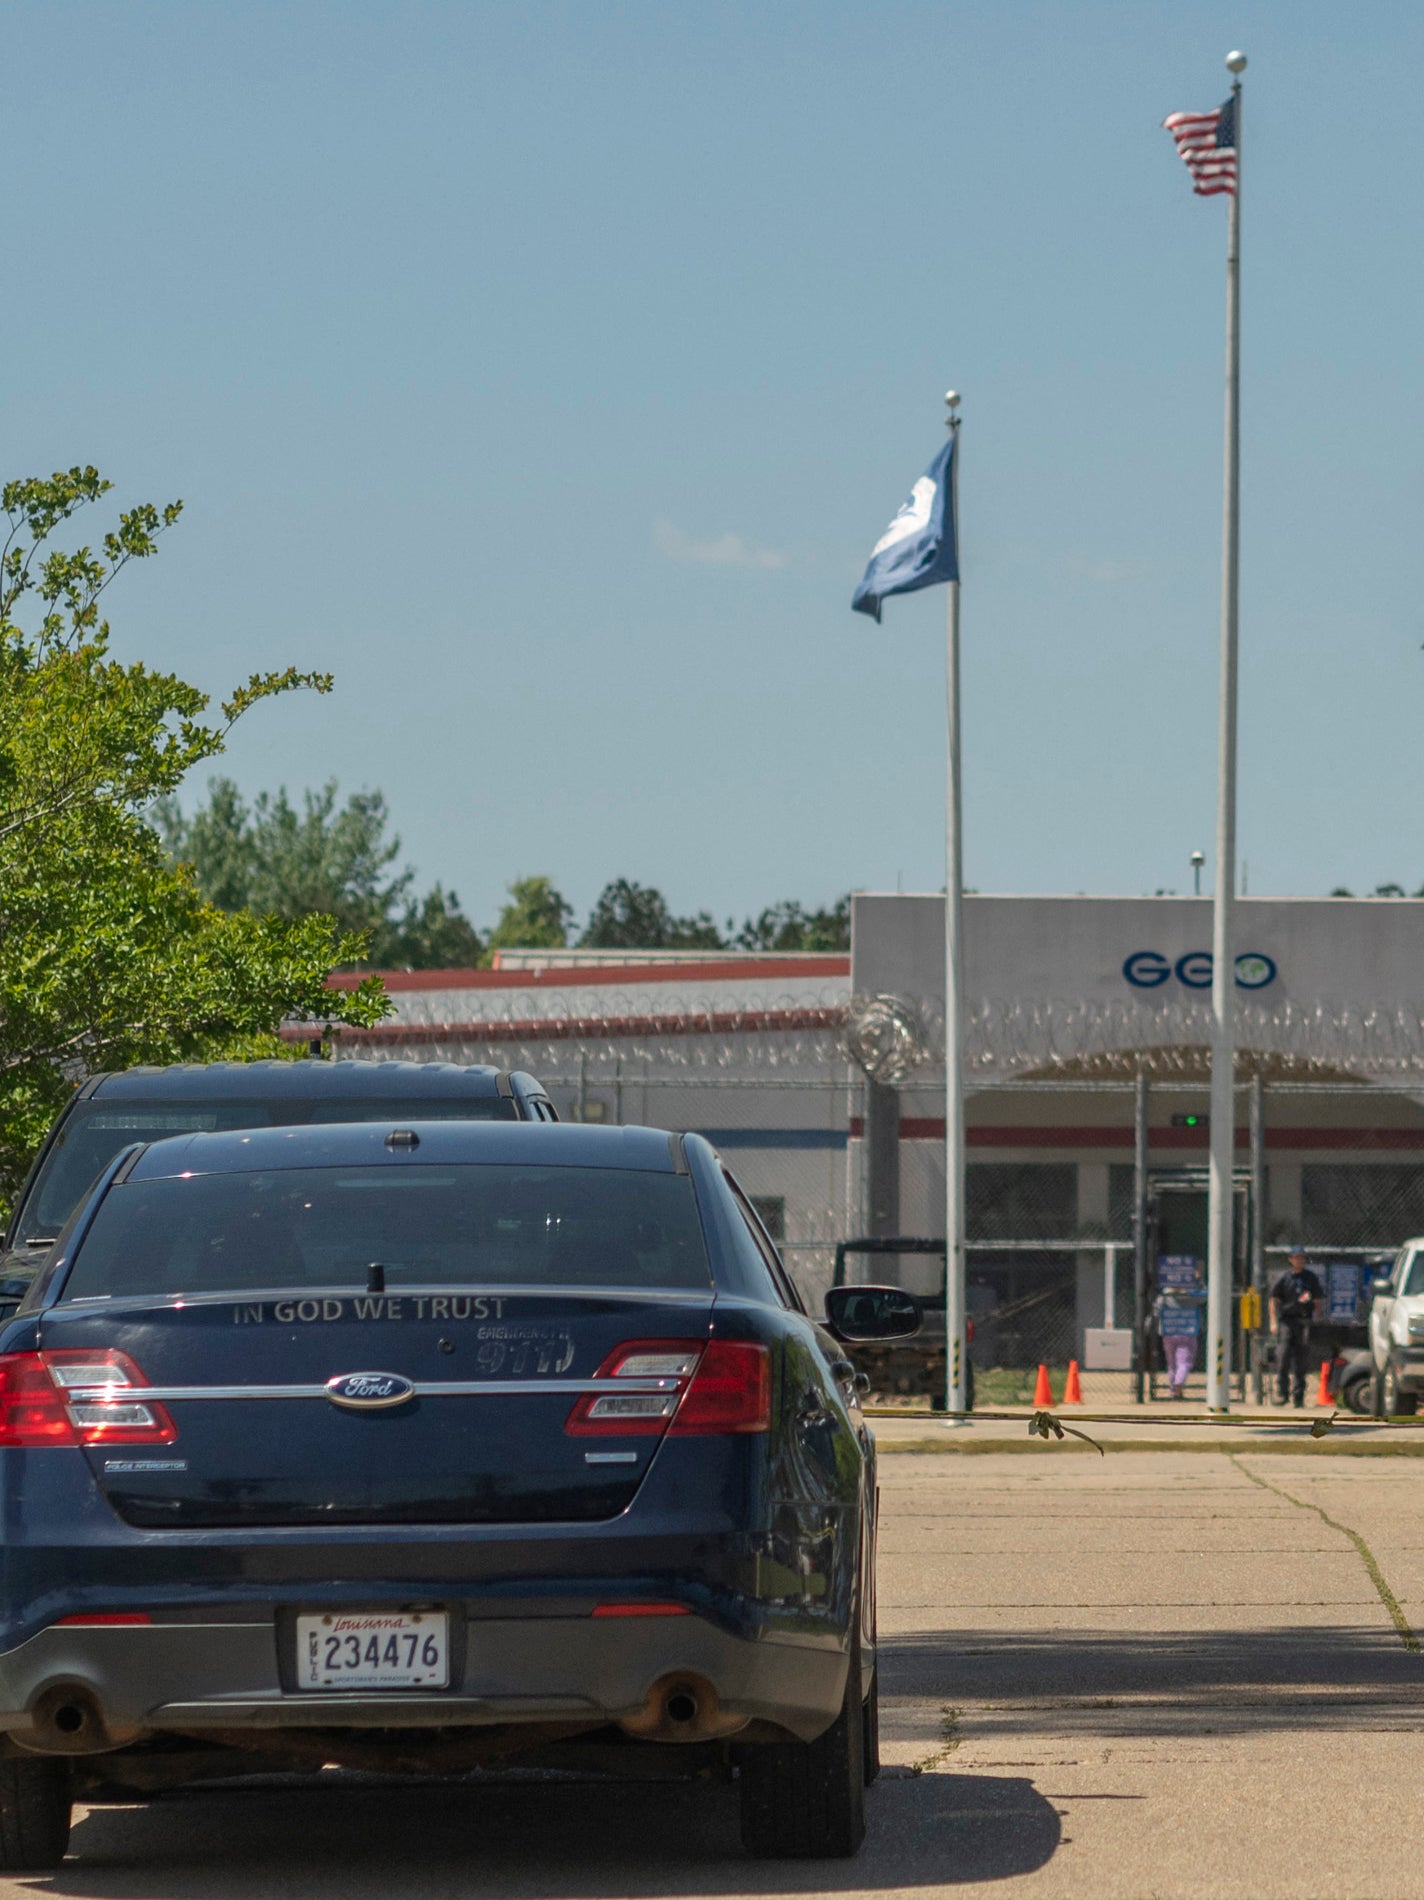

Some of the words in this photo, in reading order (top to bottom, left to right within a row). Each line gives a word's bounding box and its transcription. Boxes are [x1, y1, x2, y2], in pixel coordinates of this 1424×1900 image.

[1122, 951, 1277, 989] GEO
[233, 1301, 263, 1324] IN
[274, 1299, 343, 1322] GOD
[353, 1298, 402, 1320] WE
[412, 1297, 508, 1320] TRUST
[344, 1376, 394, 1397] Ford
[333, 1617, 410, 1633] Louisiana
[324, 1633, 439, 1670] 234476
